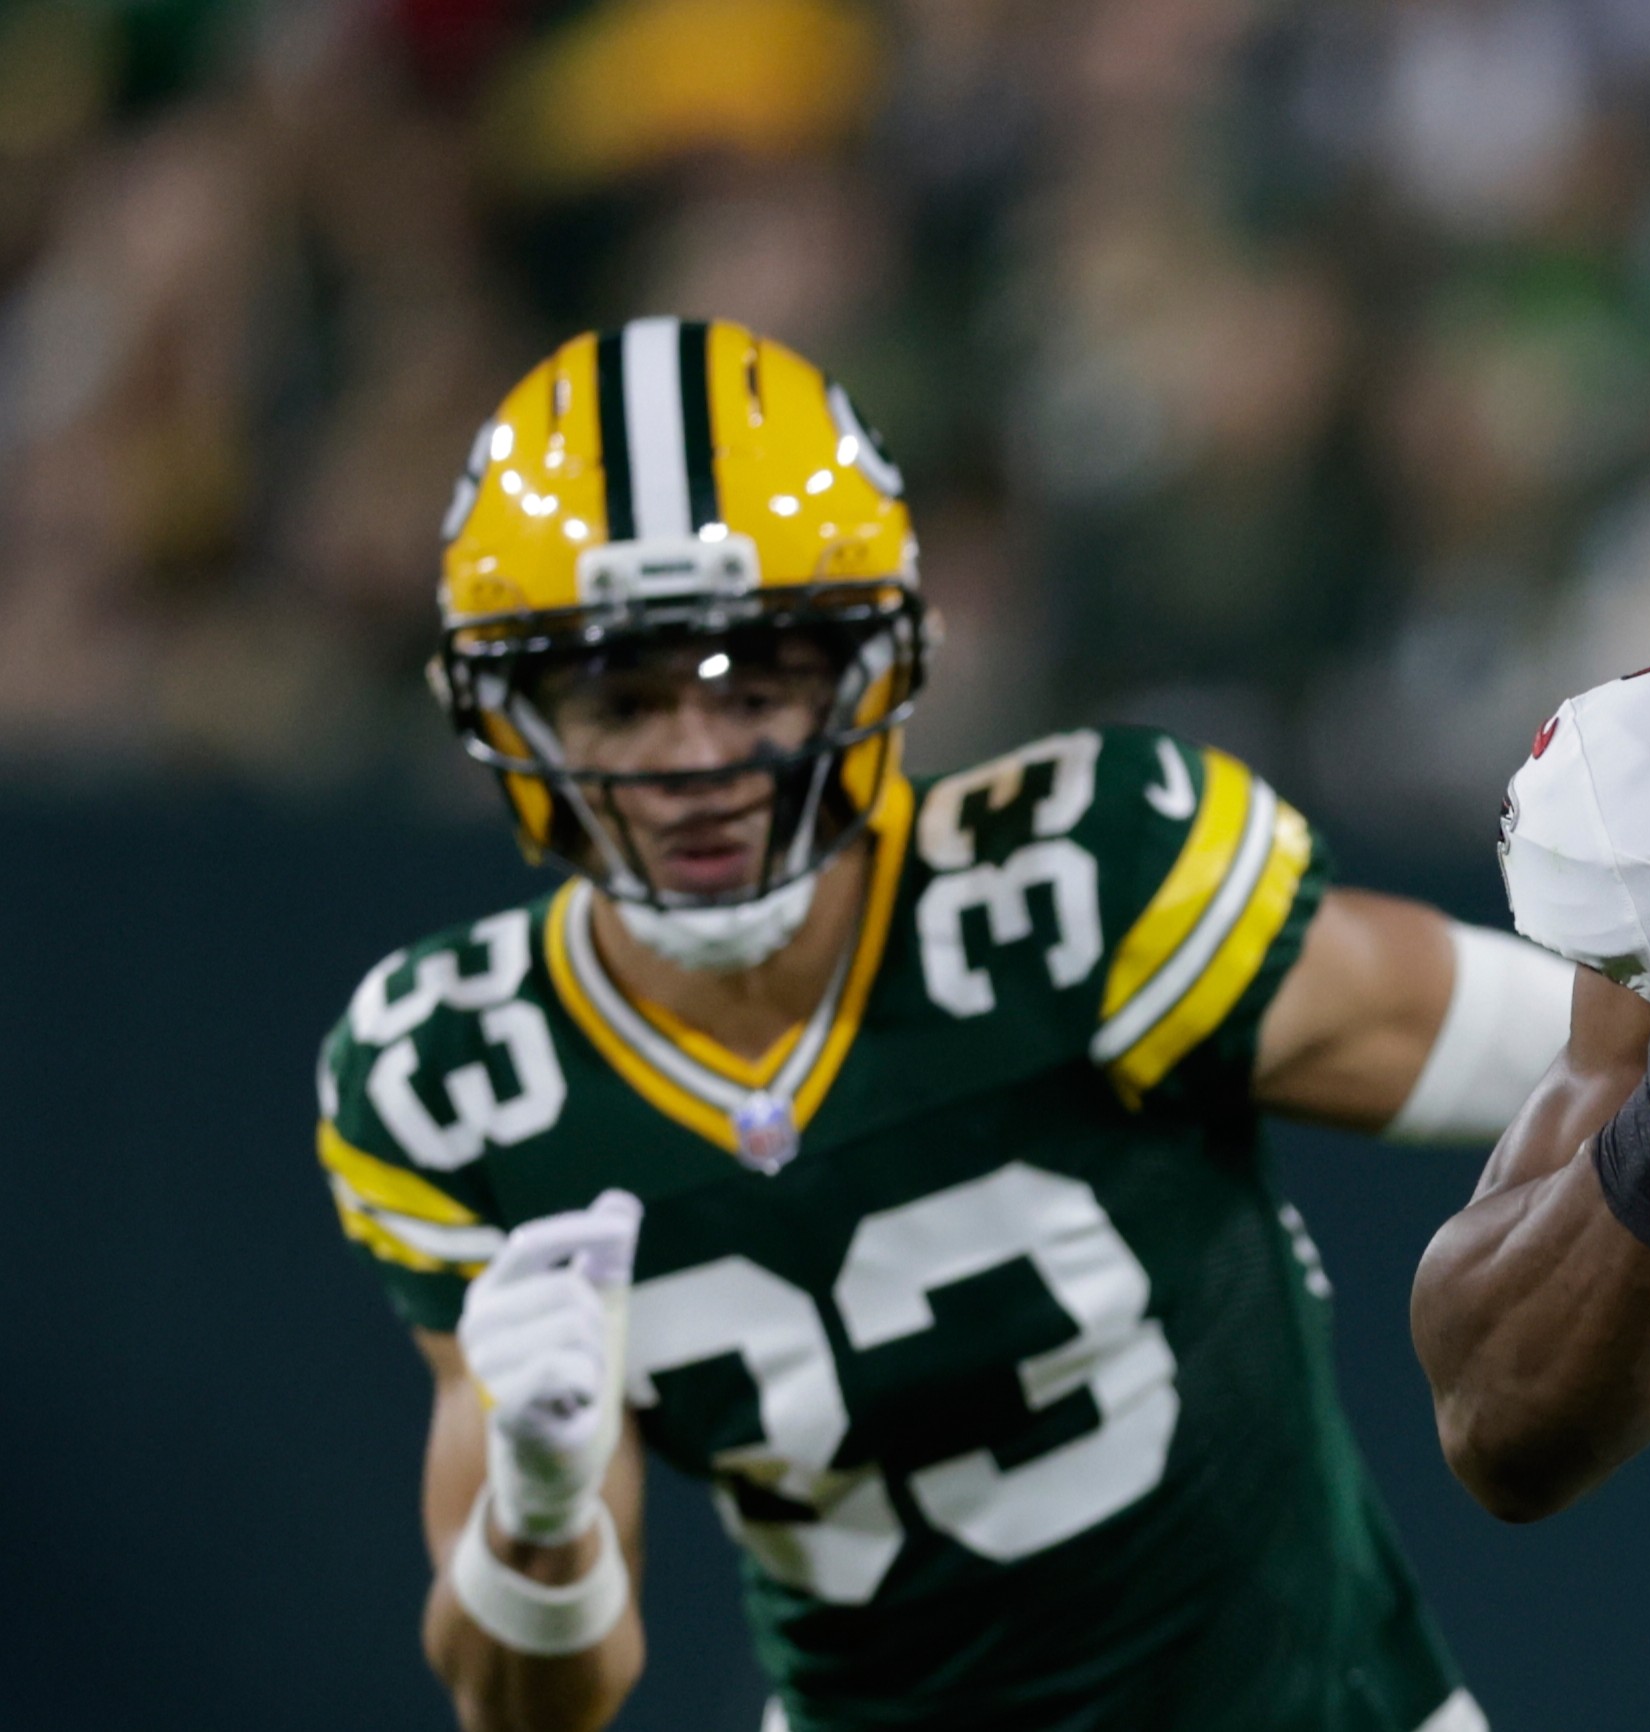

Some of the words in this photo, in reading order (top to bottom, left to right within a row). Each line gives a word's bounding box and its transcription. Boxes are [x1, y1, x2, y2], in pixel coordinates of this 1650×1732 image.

[914, 728, 1104, 1019] 33
[347, 909, 567, 1173] 33
[627, 1160, 1182, 1606] 33
